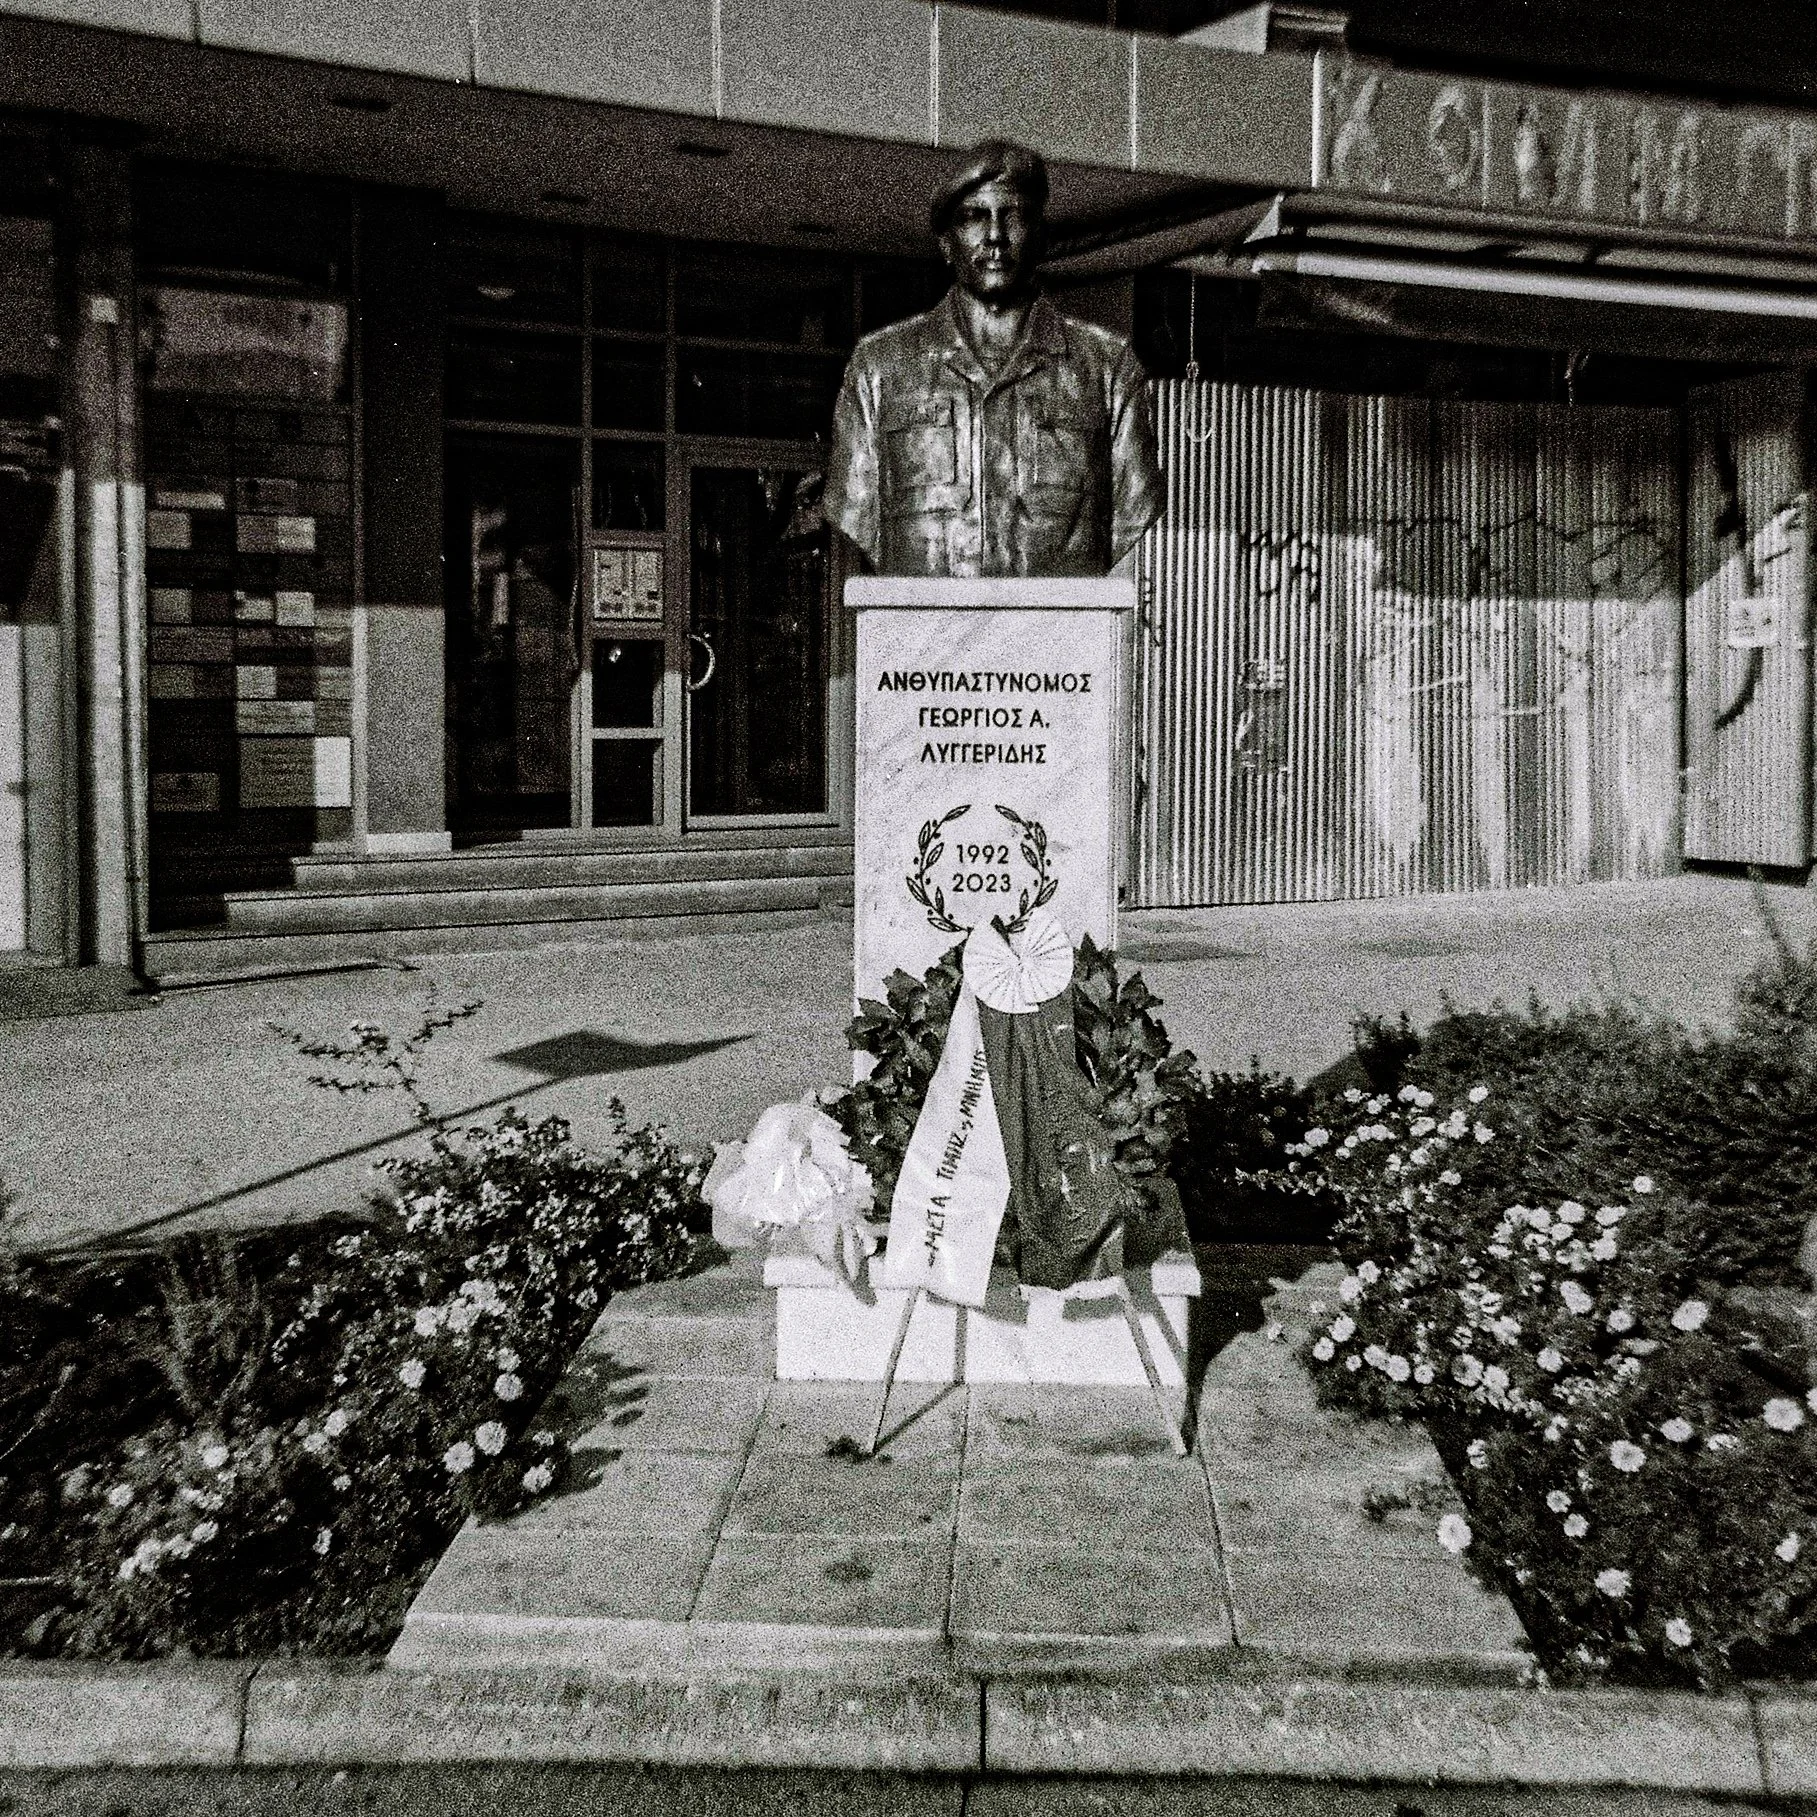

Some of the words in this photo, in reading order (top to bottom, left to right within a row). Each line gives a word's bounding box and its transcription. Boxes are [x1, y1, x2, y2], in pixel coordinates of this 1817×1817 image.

[877, 671, 1092, 693] ΑΝΘΥΠΑΣΤΥΝΟΜΟΣ
[918, 707, 1023, 729] ΓΕΩΡΓΙΟΣ
[1029, 709, 1050, 729] Α.
[920, 742, 1047, 764] ΛΥΓΓΕΡΙΔΗΣ
[956, 844, 1009, 865] 1992
[952, 873, 1011, 893] 2023
